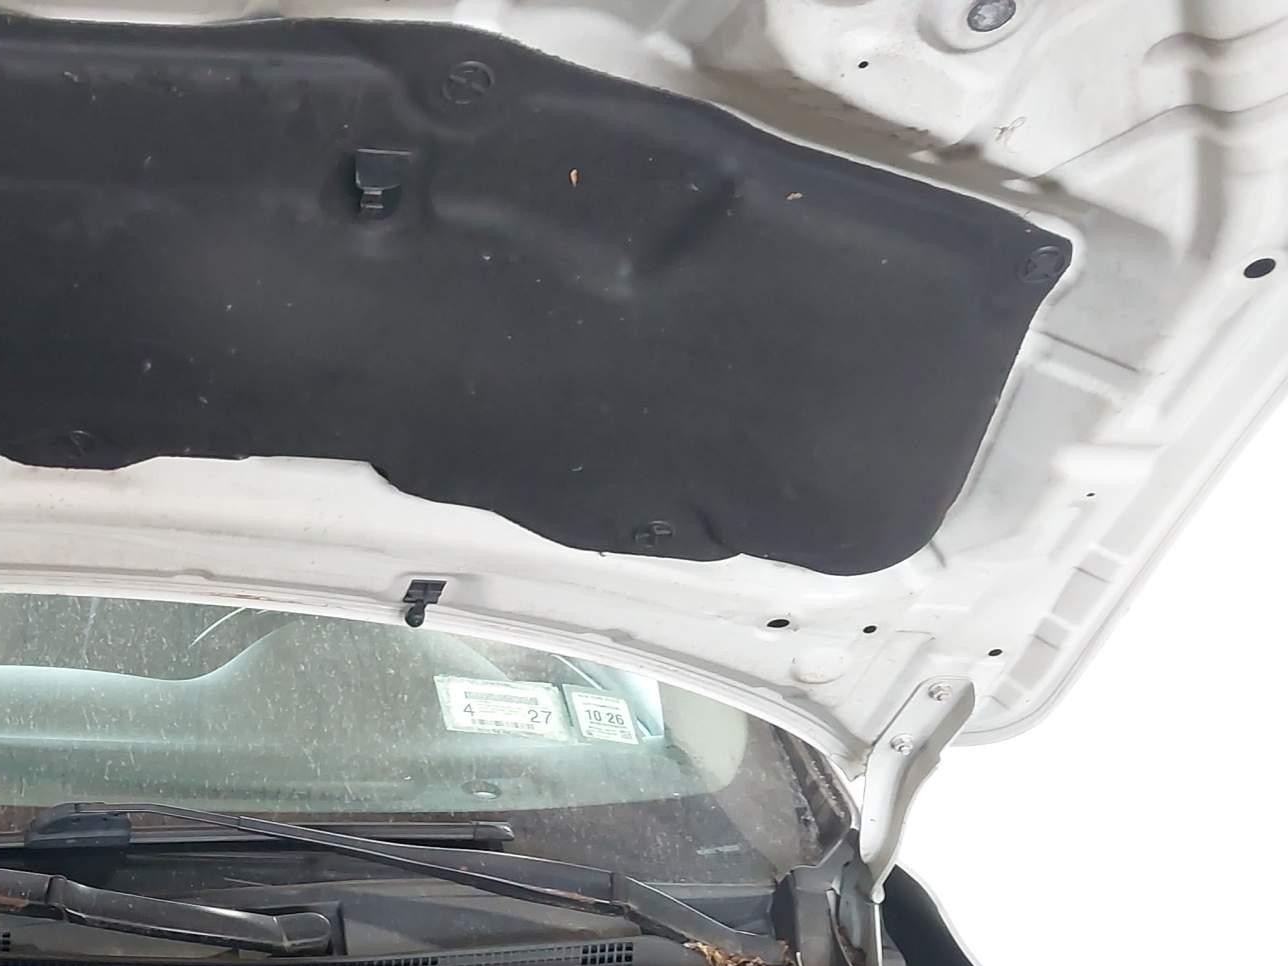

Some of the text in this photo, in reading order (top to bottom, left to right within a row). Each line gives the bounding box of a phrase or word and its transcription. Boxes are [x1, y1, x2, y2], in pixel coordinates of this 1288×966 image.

[463, 703, 475, 717] 4
[527, 709, 552, 725] 27
[585, 709, 625, 726] 10 26
